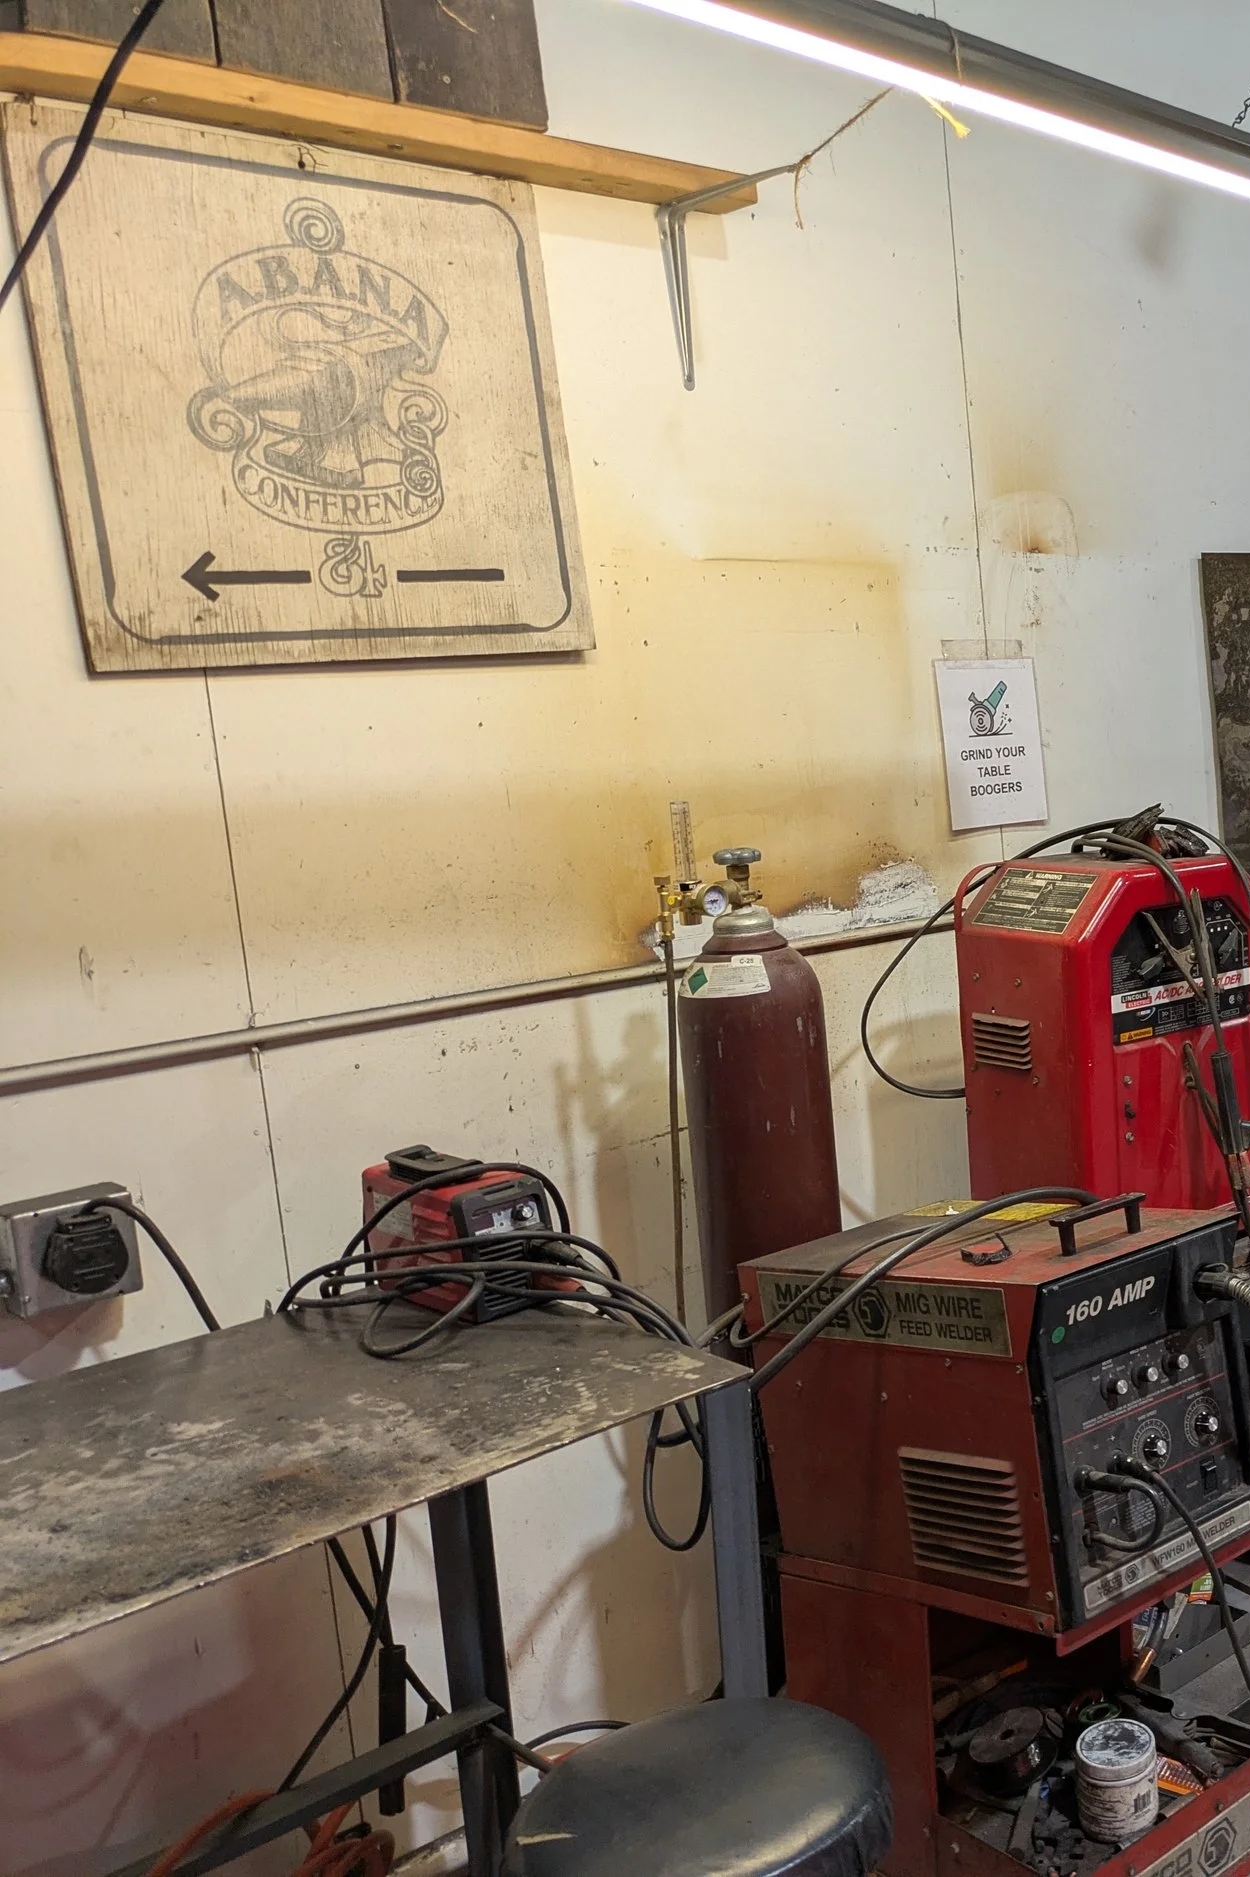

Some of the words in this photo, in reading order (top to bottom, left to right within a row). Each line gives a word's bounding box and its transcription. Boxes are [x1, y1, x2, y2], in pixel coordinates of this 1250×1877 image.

[960, 748, 993, 762] GRIND
[995, 746, 1026, 758] YOUR
[977, 764, 1012, 778] TABLE
[970, 781, 1023, 797] BOOGERS
[1122, 992, 1148, 1003] LINCOLN
[1154, 986, 1184, 1002] AC/DC
[895, 1292, 934, 1314] MIG
[934, 1294, 984, 1320] WIRE
[1066, 1295, 1103, 1326] 160
[1107, 1275, 1156, 1311] AMP
[899, 1319, 932, 1337] FEED
[936, 1323, 992, 1343] WELDER
[1202, 1516, 1236, 1540] WELDER
